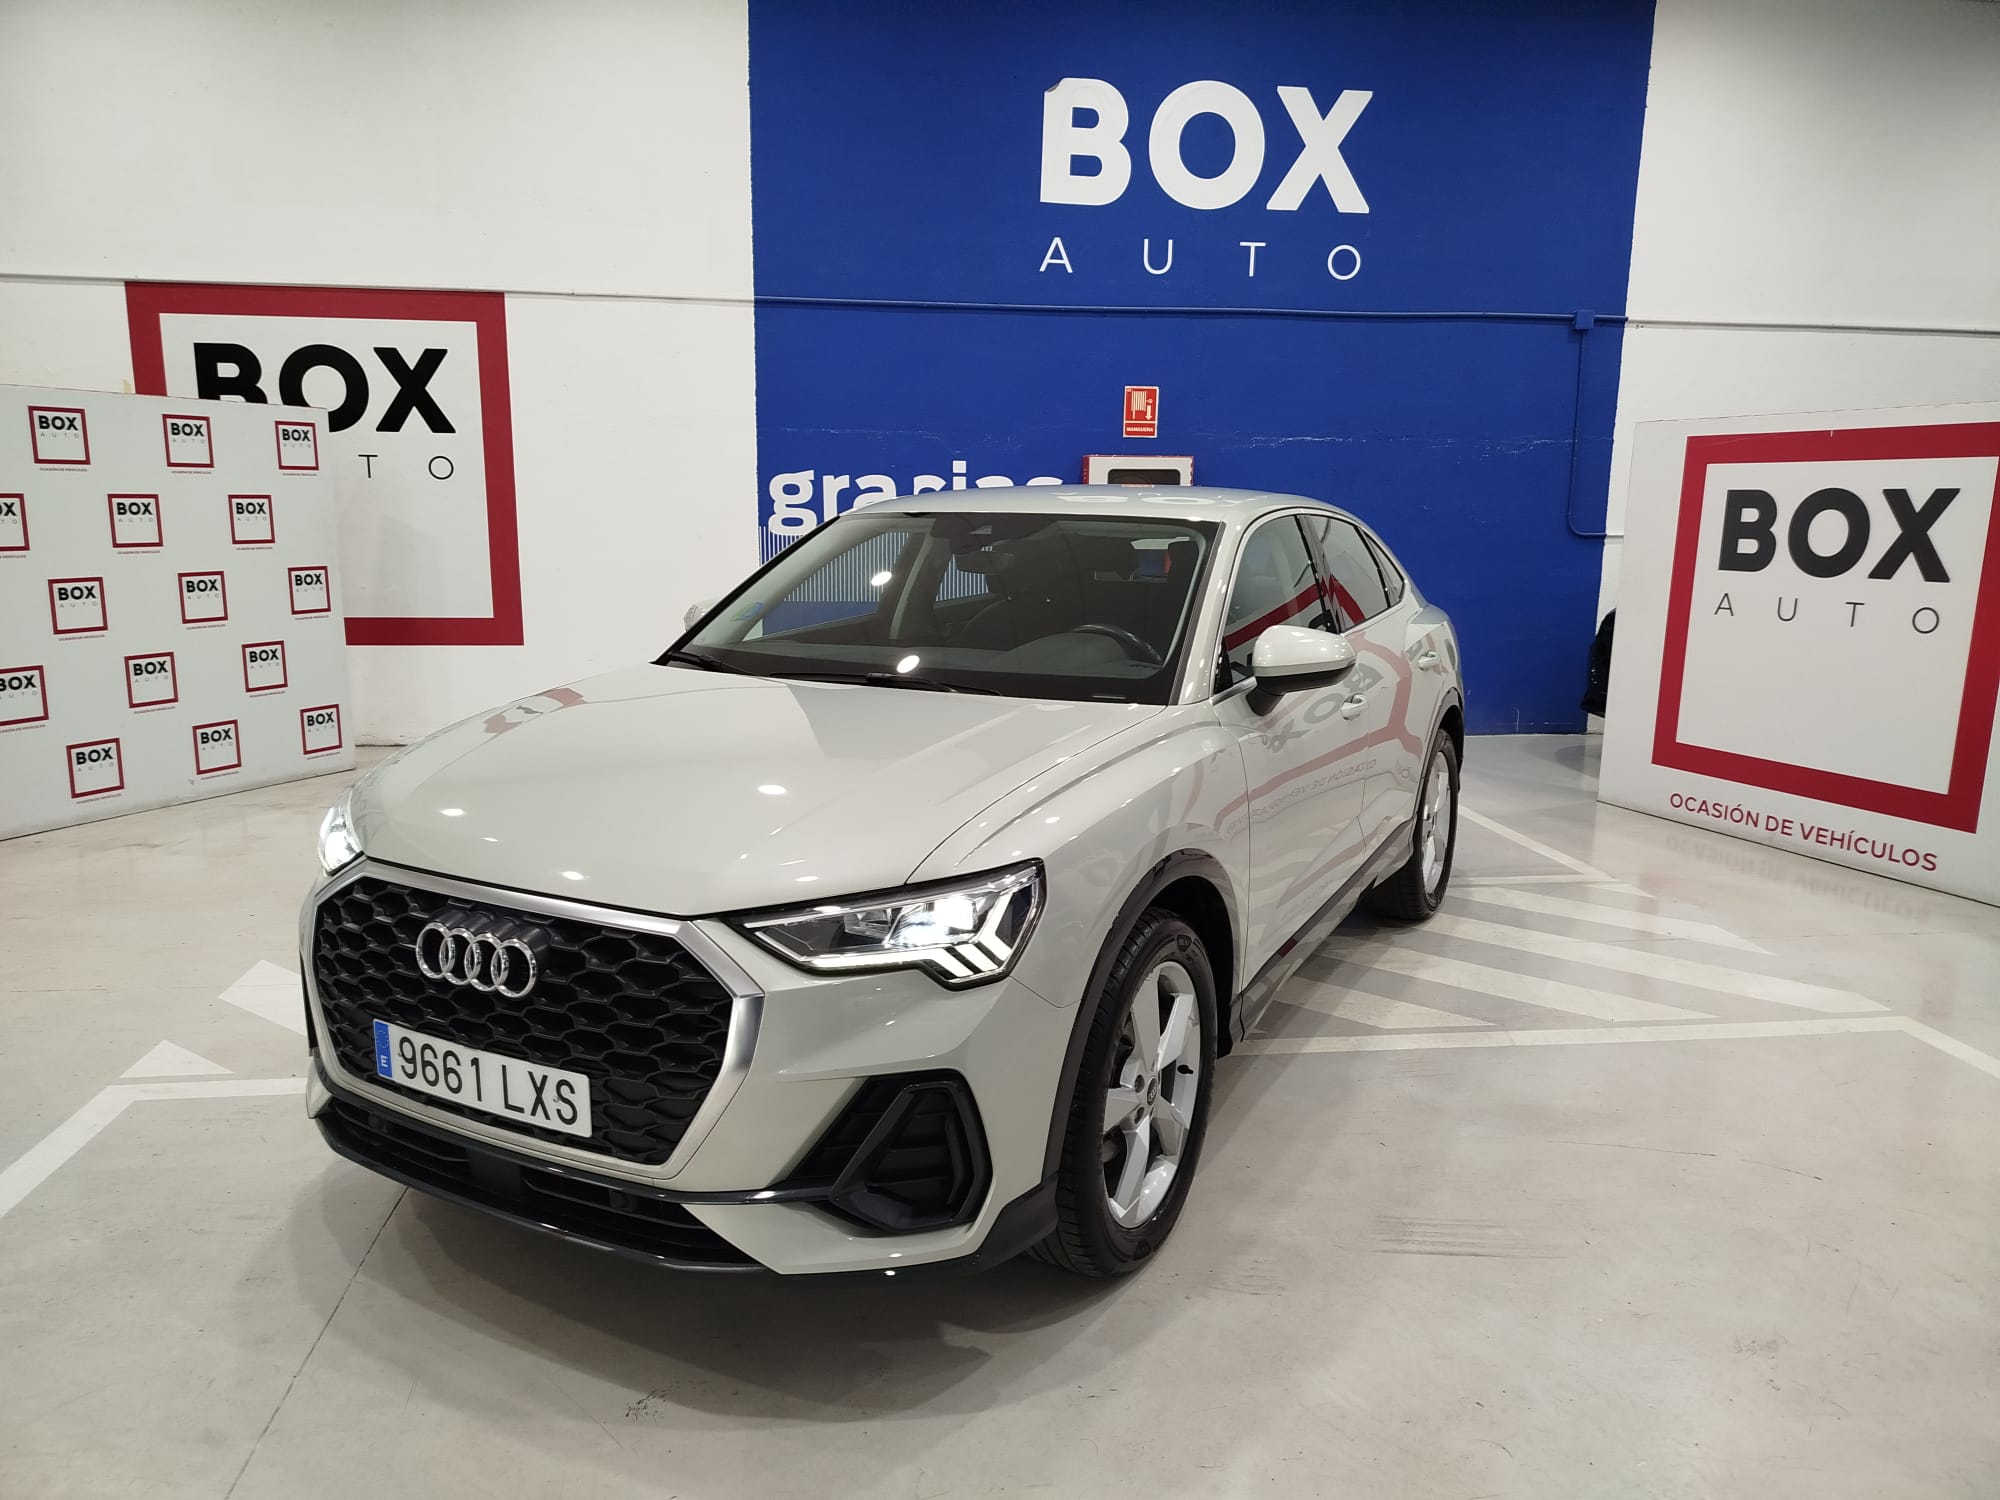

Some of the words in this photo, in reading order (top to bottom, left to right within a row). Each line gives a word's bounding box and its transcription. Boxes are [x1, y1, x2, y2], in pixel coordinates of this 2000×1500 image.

[1040, 77, 1373, 213] BOX
[1039, 237, 1361, 280] AUTO
[193, 342, 456, 433] BOX
[38, 415, 79, 431] BOX
[170, 422, 205, 437] BOX
[282, 428, 311, 442] BOX
[116, 502, 153, 516] BOX
[235, 502, 267, 515] BOX
[1718, 487, 1960, 584] BOX
[186, 579, 219, 593] BOX
[295, 573, 323, 587] BOX
[57, 585, 97, 601] BOX
[1714, 593, 1940, 634] AUTO
[249, 648, 280, 663] BOX
[132, 660, 169, 677] BOX
[306, 711, 335, 727] BOX
[200, 727, 233, 745] BOX
[75, 747, 114, 766] BOX
[1670, 793, 1759, 829] OCASIÓN
[1765, 815, 1794, 837] DE
[1800, 822, 1938, 872] VEHÍCULOS
[380, 1055, 389, 1068] E
[399, 1036, 483, 1102] 9661
[501, 1065, 578, 1125] LXS
